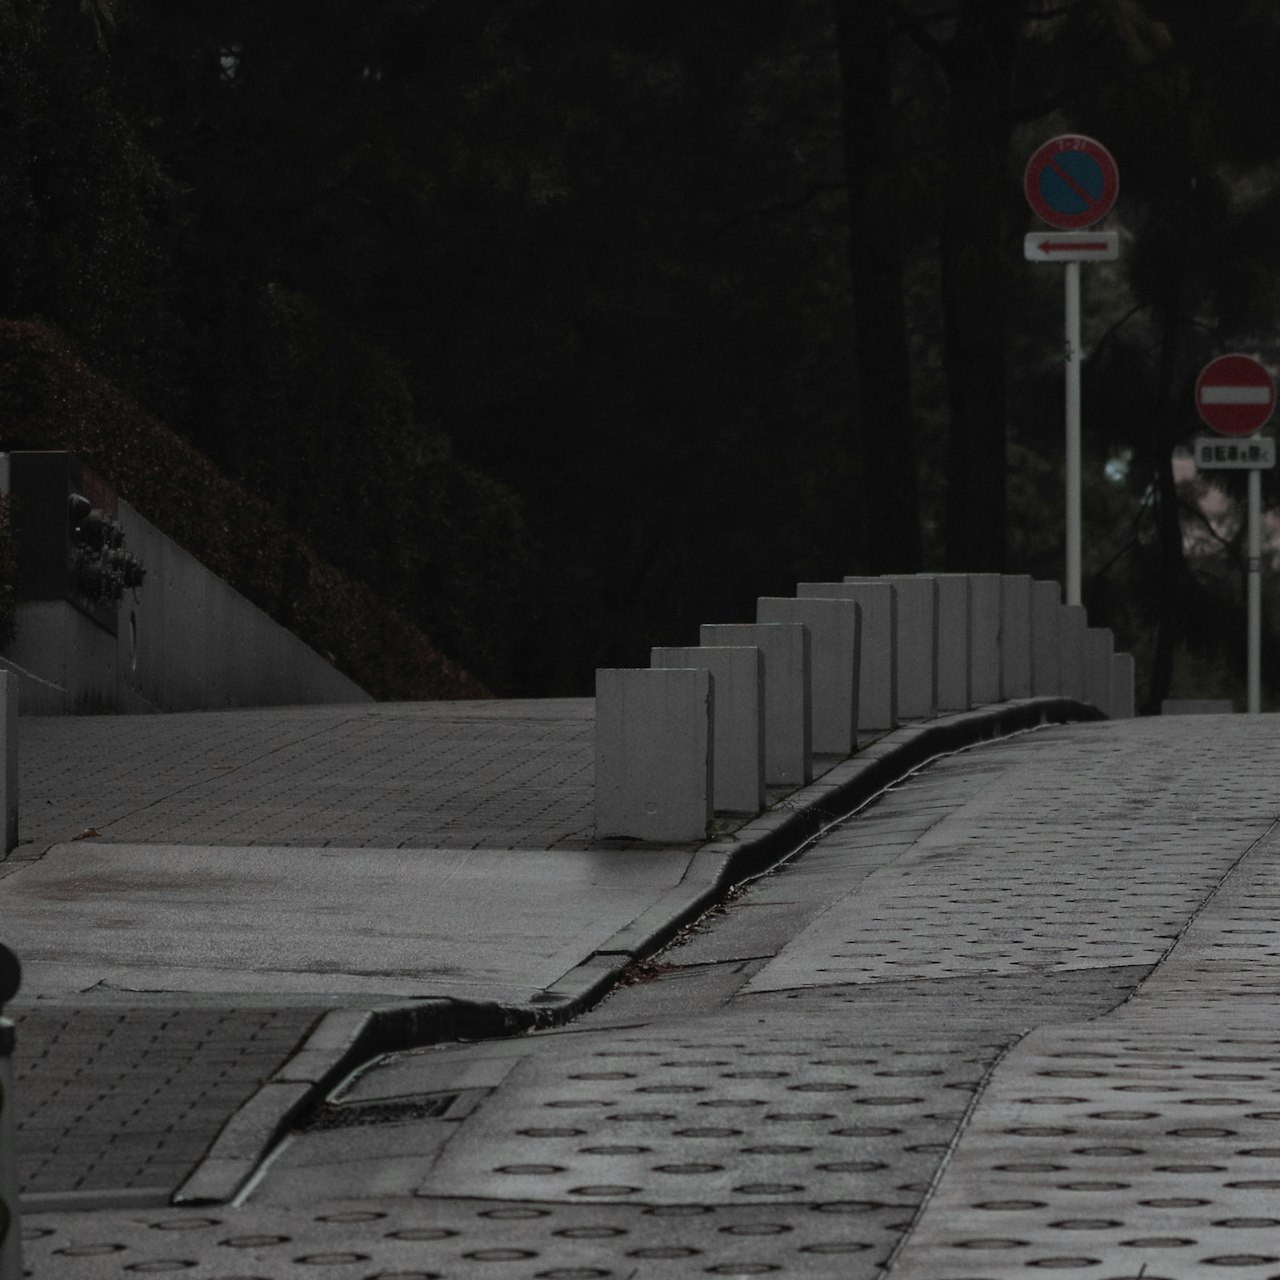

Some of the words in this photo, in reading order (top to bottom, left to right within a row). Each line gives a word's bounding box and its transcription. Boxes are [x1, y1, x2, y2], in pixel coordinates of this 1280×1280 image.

[1202, 445, 1270, 463] 自転車を除く
